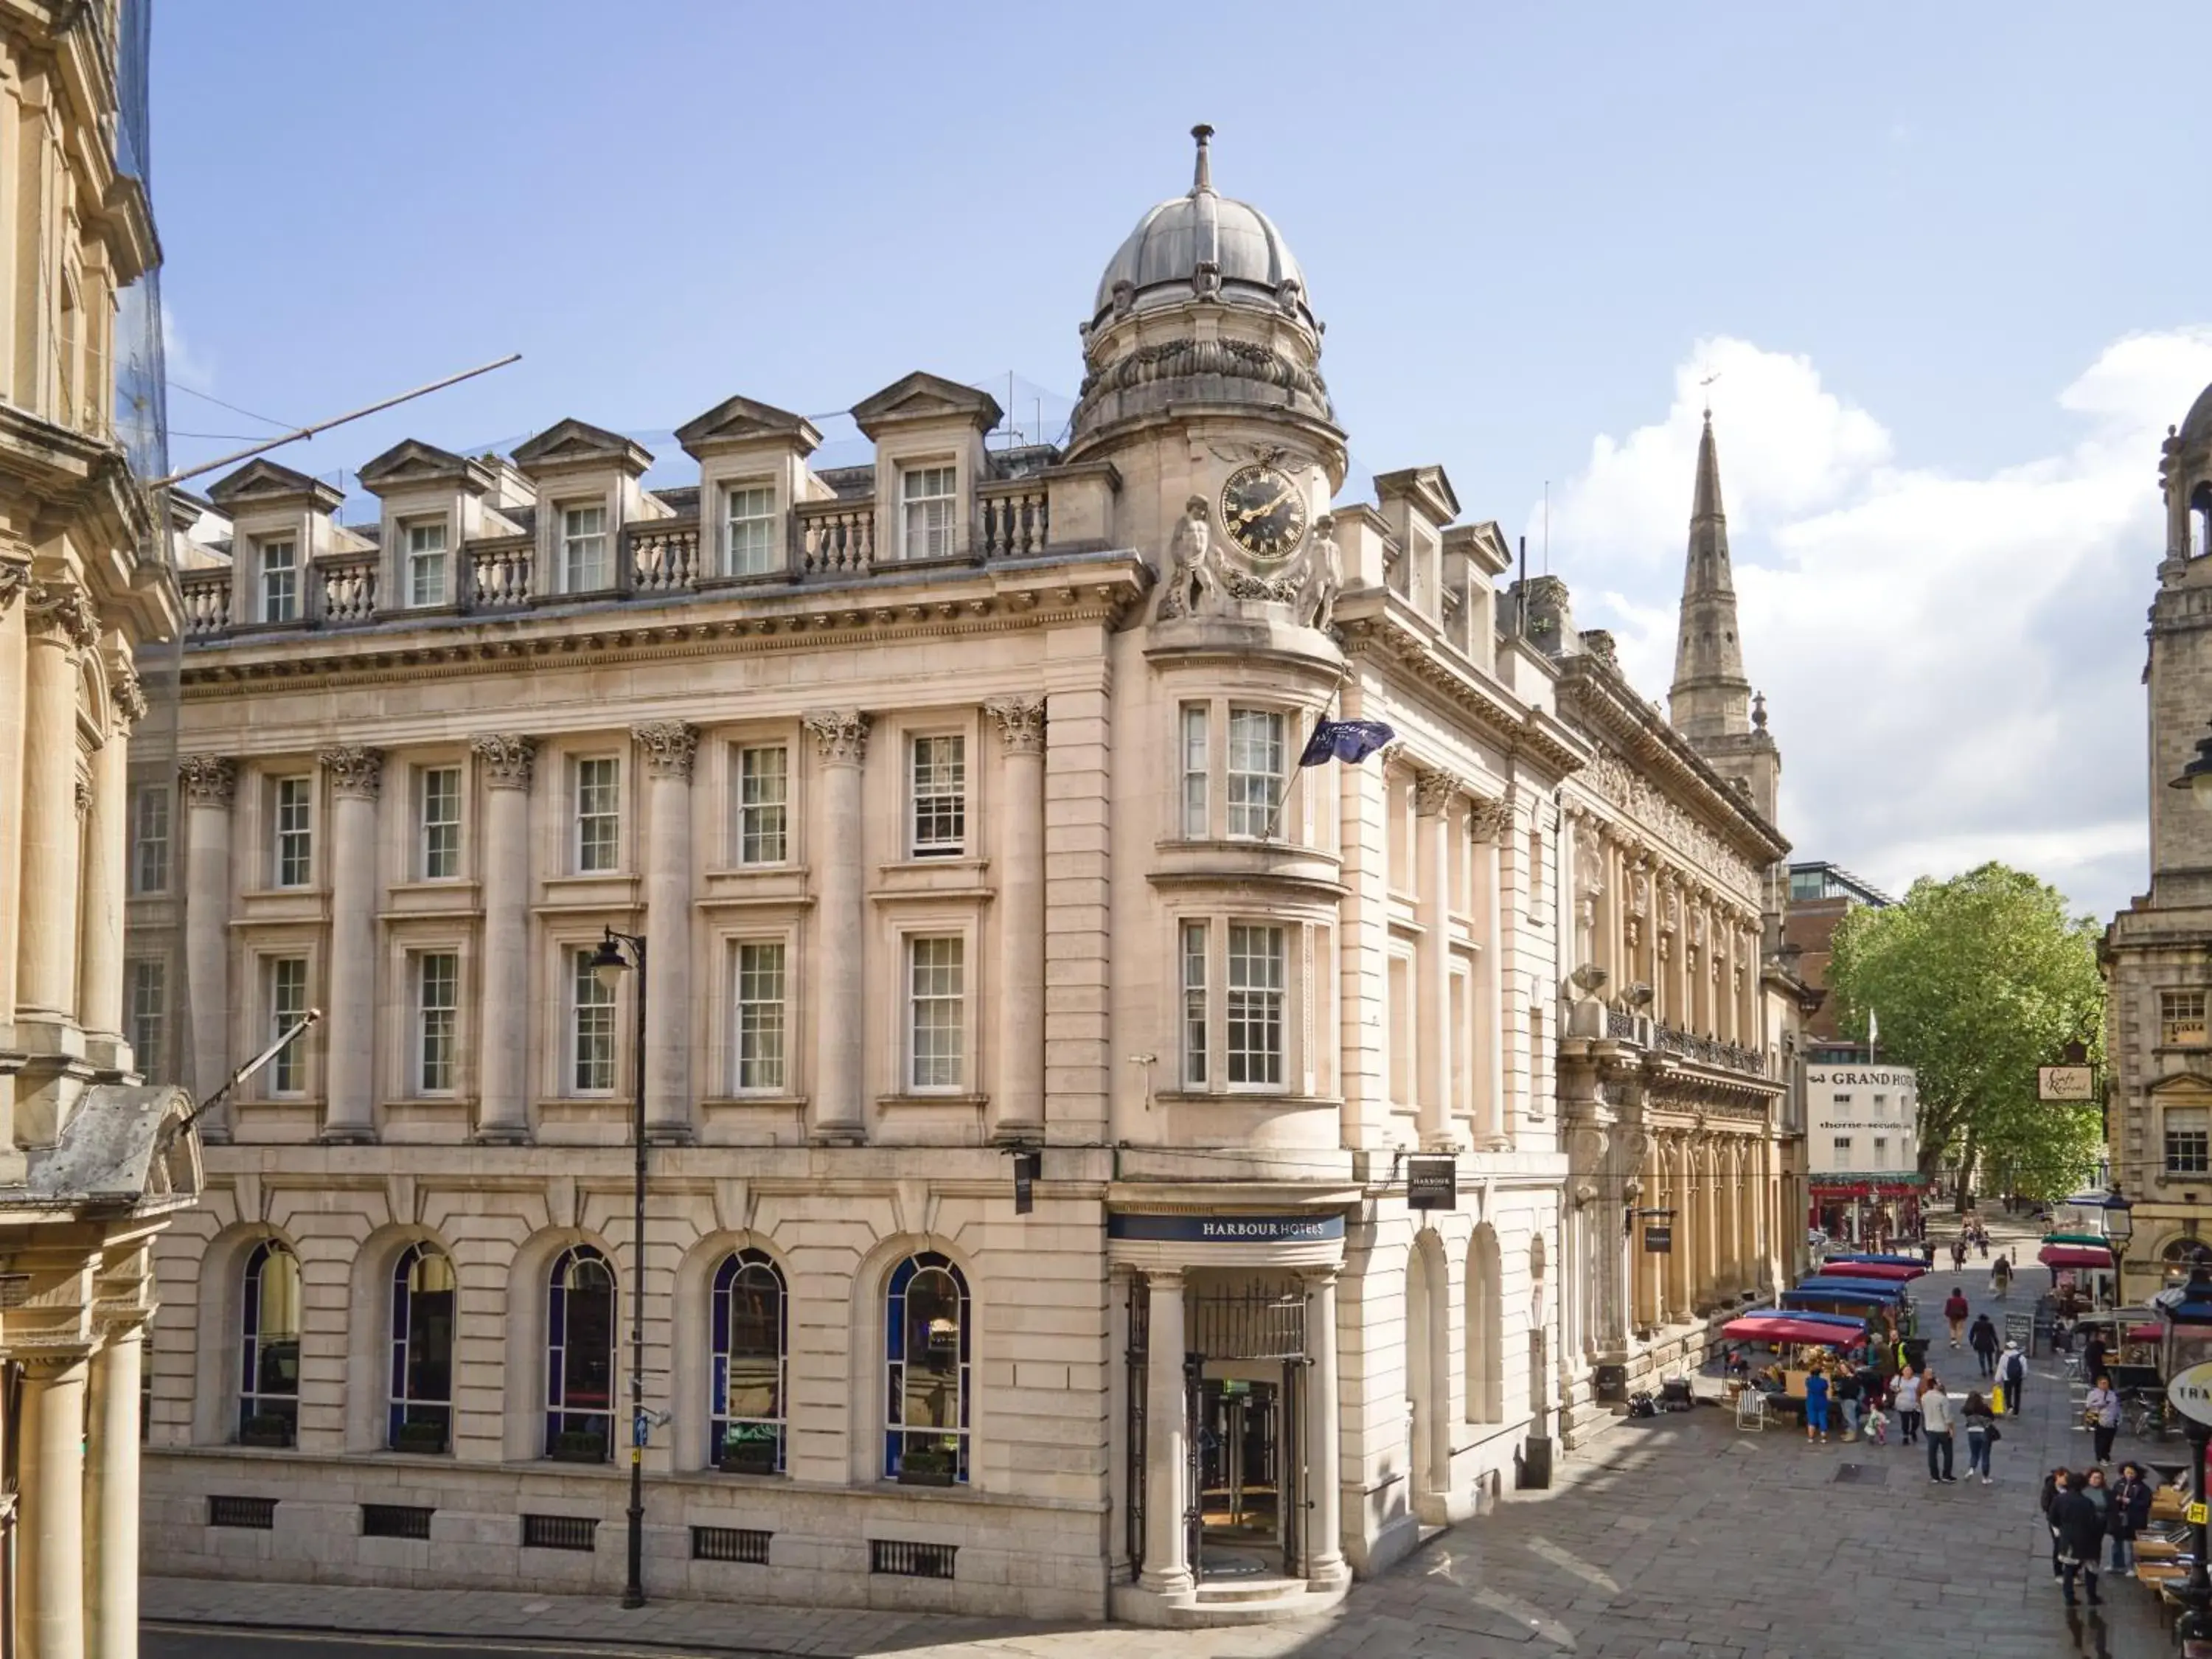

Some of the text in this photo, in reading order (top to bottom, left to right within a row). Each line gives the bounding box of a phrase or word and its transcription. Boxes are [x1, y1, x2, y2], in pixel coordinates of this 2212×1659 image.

[1832, 1073, 1890, 1085] GRAND
[1203, 1222, 1324, 1236] HARBOUR HOTELS
